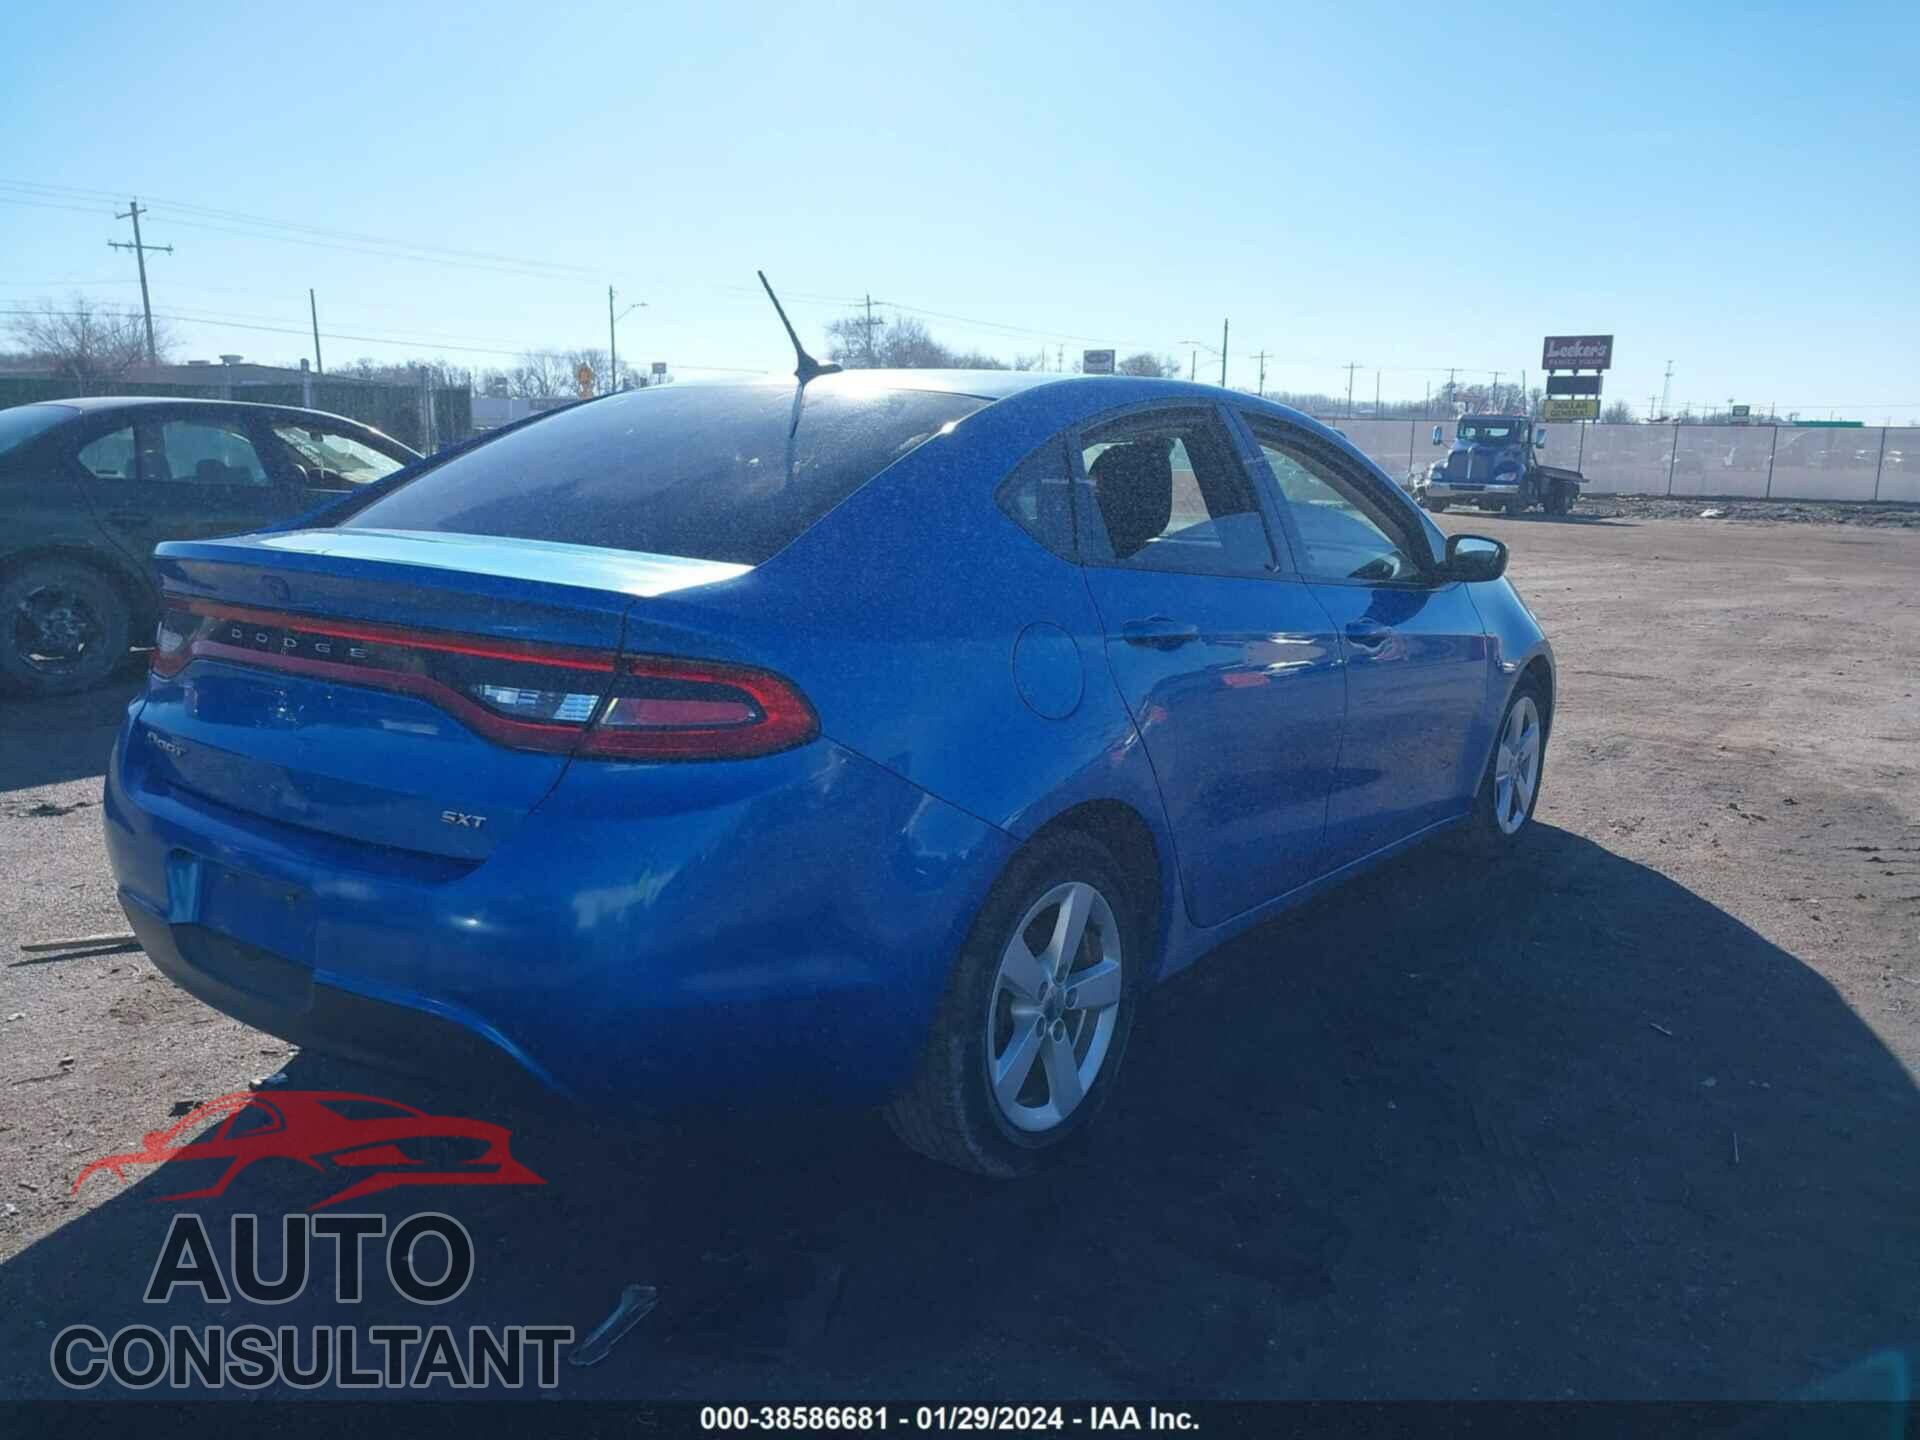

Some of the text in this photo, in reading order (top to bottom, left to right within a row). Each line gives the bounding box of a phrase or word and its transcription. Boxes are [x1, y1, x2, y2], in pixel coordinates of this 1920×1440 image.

[1553, 401, 1587, 409] DOLLAR
[231, 628, 369, 658] DODGE
[439, 810, 487, 828] SXT
